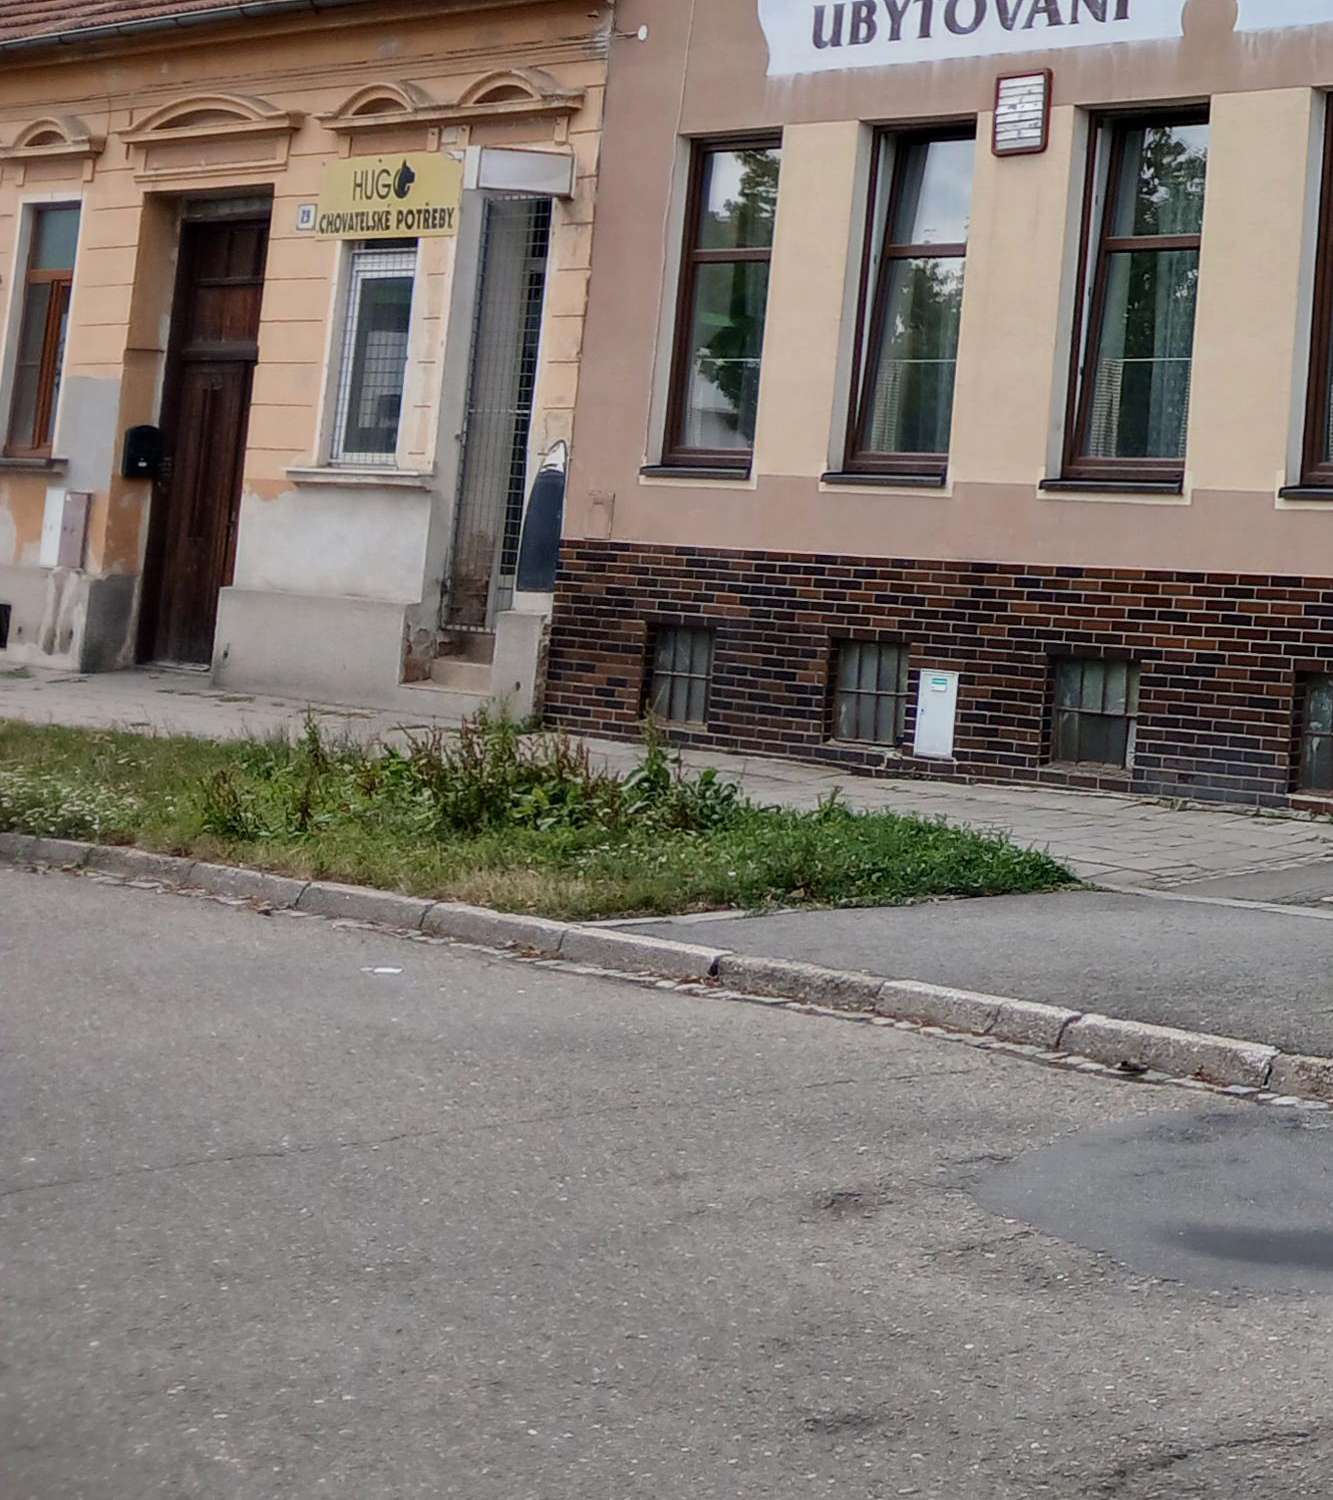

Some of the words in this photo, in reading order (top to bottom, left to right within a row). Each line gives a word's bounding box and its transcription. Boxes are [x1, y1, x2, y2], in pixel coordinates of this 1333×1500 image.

[353, 160, 415, 200] HUGO
[319, 204, 391, 234] CHOVATELSKÉ
[396, 203, 455, 230] POTŘEBY
